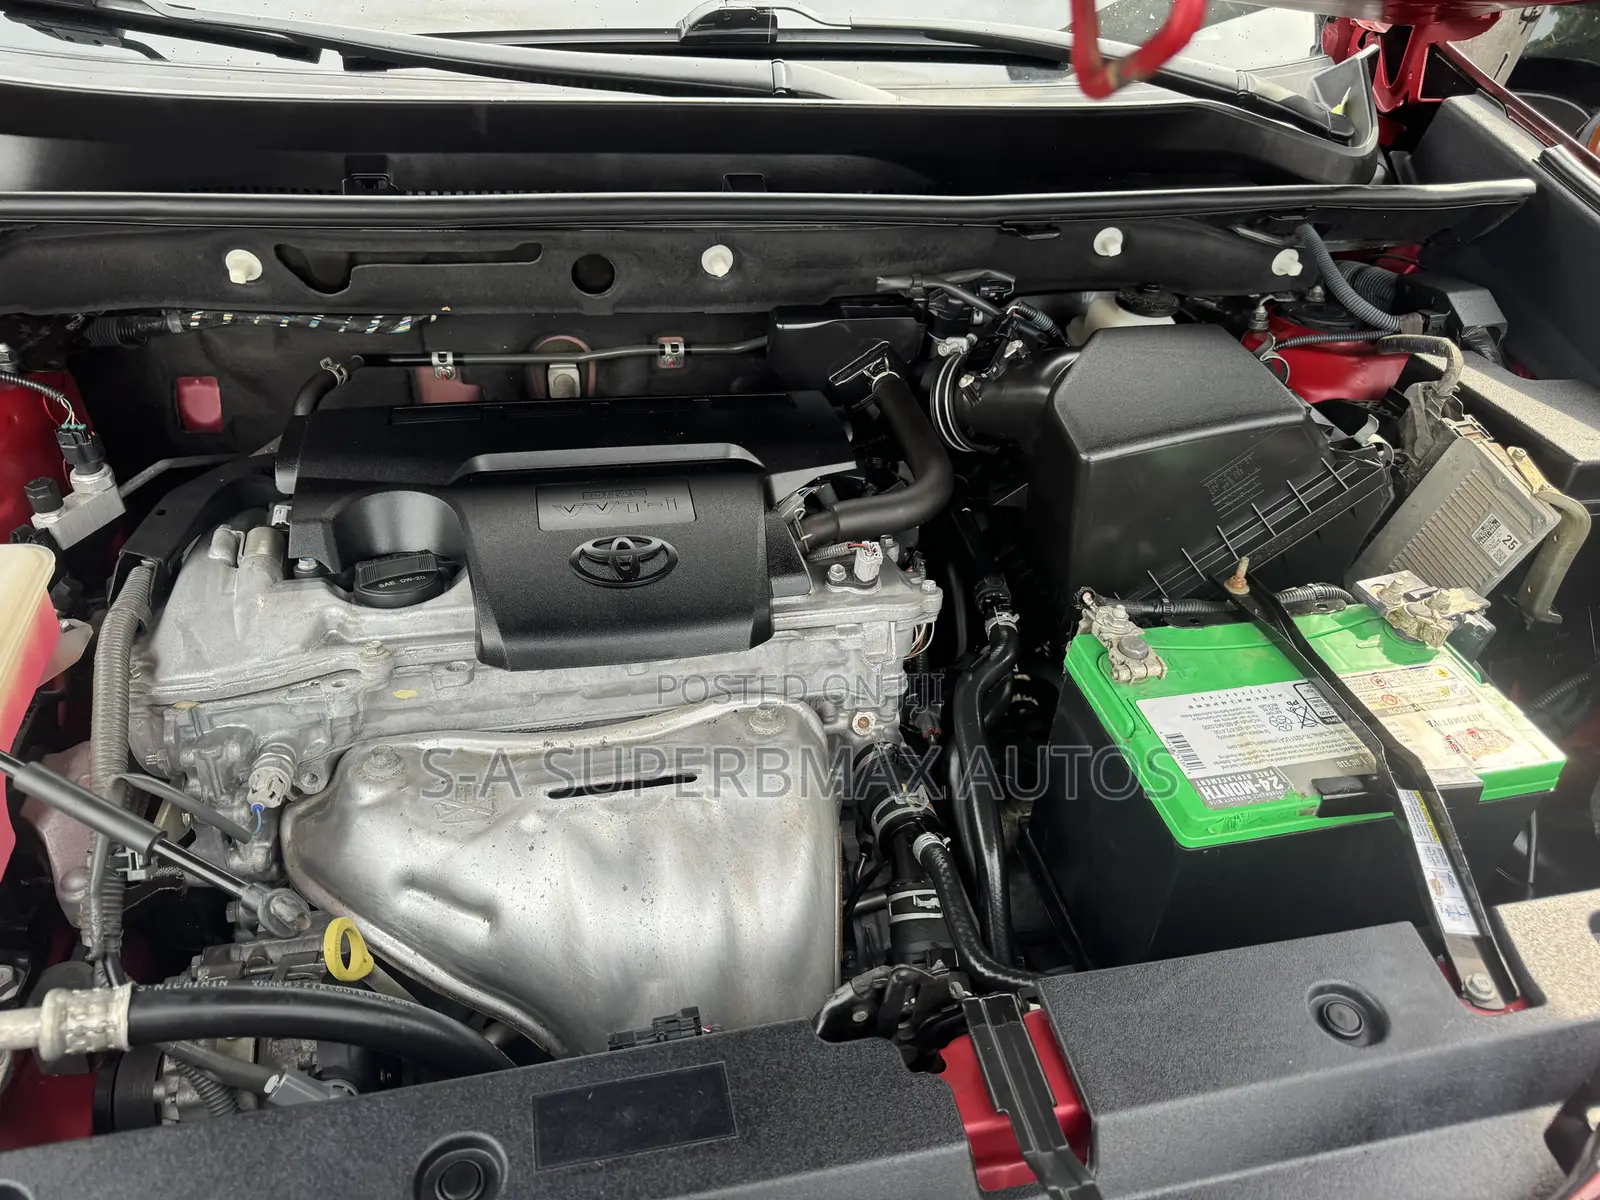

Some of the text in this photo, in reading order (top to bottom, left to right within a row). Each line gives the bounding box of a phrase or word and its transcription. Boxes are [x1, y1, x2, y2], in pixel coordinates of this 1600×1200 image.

[1502, 534, 1518, 551] 25
[378, 575, 426, 588] SAE 0W-20
[1424, 710, 1486, 729] AUTOMOTIVE
[1193, 769, 1275, 787] FREE REPLACEMENT
[1198, 774, 1285, 802] 24-MONTH
